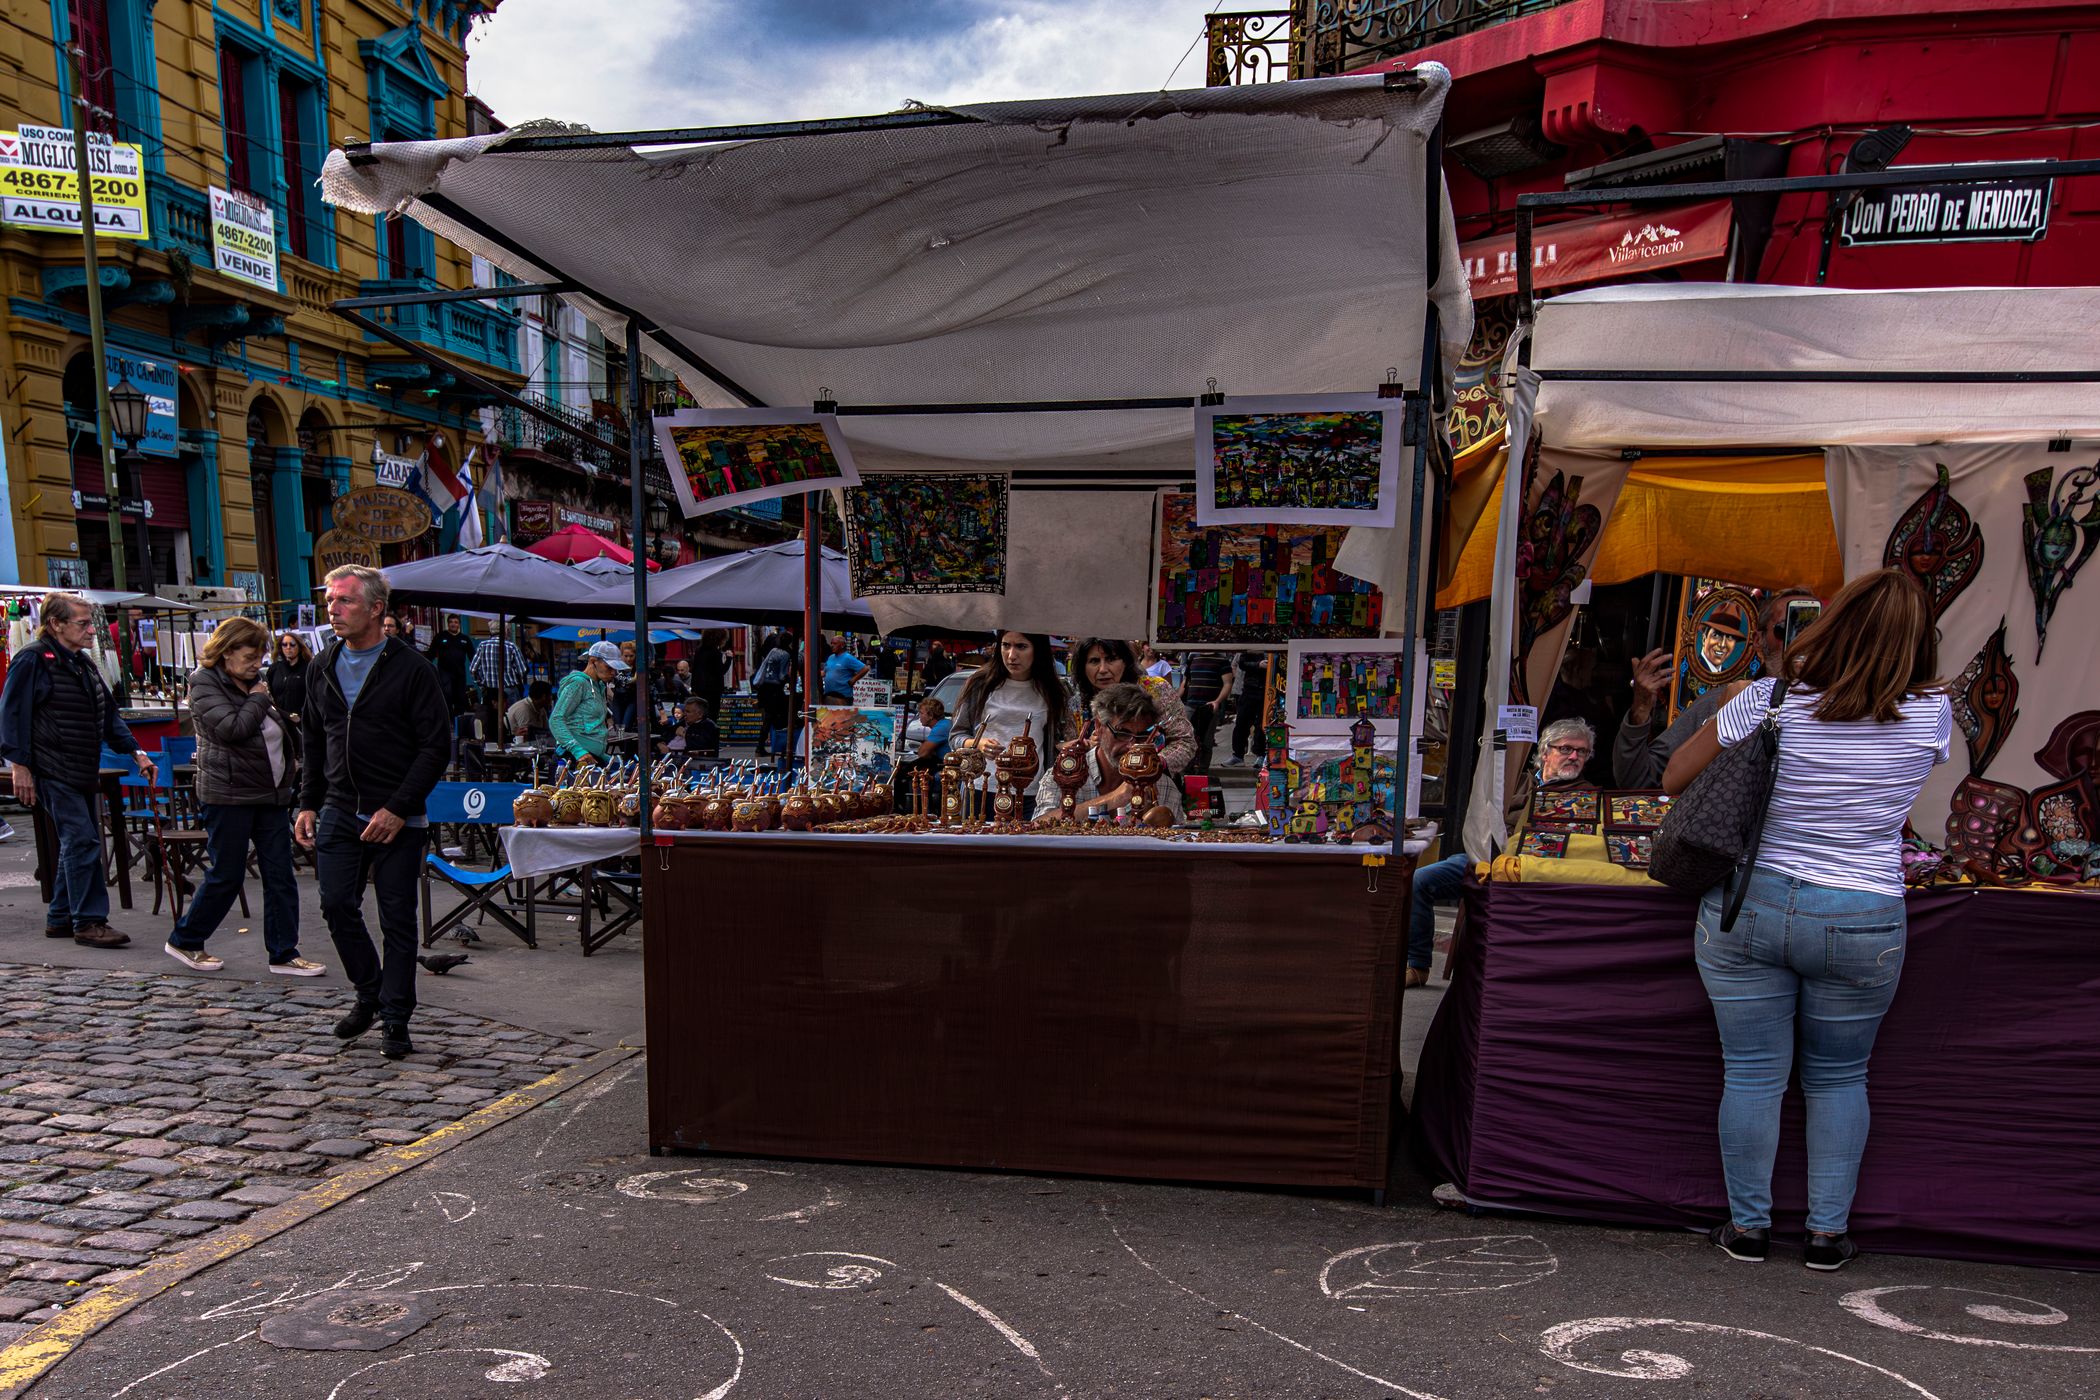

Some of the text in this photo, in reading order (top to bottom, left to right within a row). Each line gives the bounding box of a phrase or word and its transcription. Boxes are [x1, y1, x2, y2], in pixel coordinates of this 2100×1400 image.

[22, 127, 111, 146] USO COMCIAL
[4, 170, 139, 198] 4867-200
[15, 188, 93, 200] CORRIENT
[13, 204, 126, 227] ALQULA
[1886, 191, 1941, 234] PEDRO
[1965, 188, 2043, 231] MENDOZA
[217, 223, 273, 254] 4867-2200
[1609, 238, 1684, 263] Villavicencio
[221, 252, 272, 280] VENDE
[1495, 242, 1558, 275] PELA
[136, 361, 175, 387] CAMINITO
[379, 461, 415, 482] ZARAT
[351, 492, 409, 509] MUSEO
[372, 509, 391, 521] DE
[320, 551, 371, 570] MUSEO
